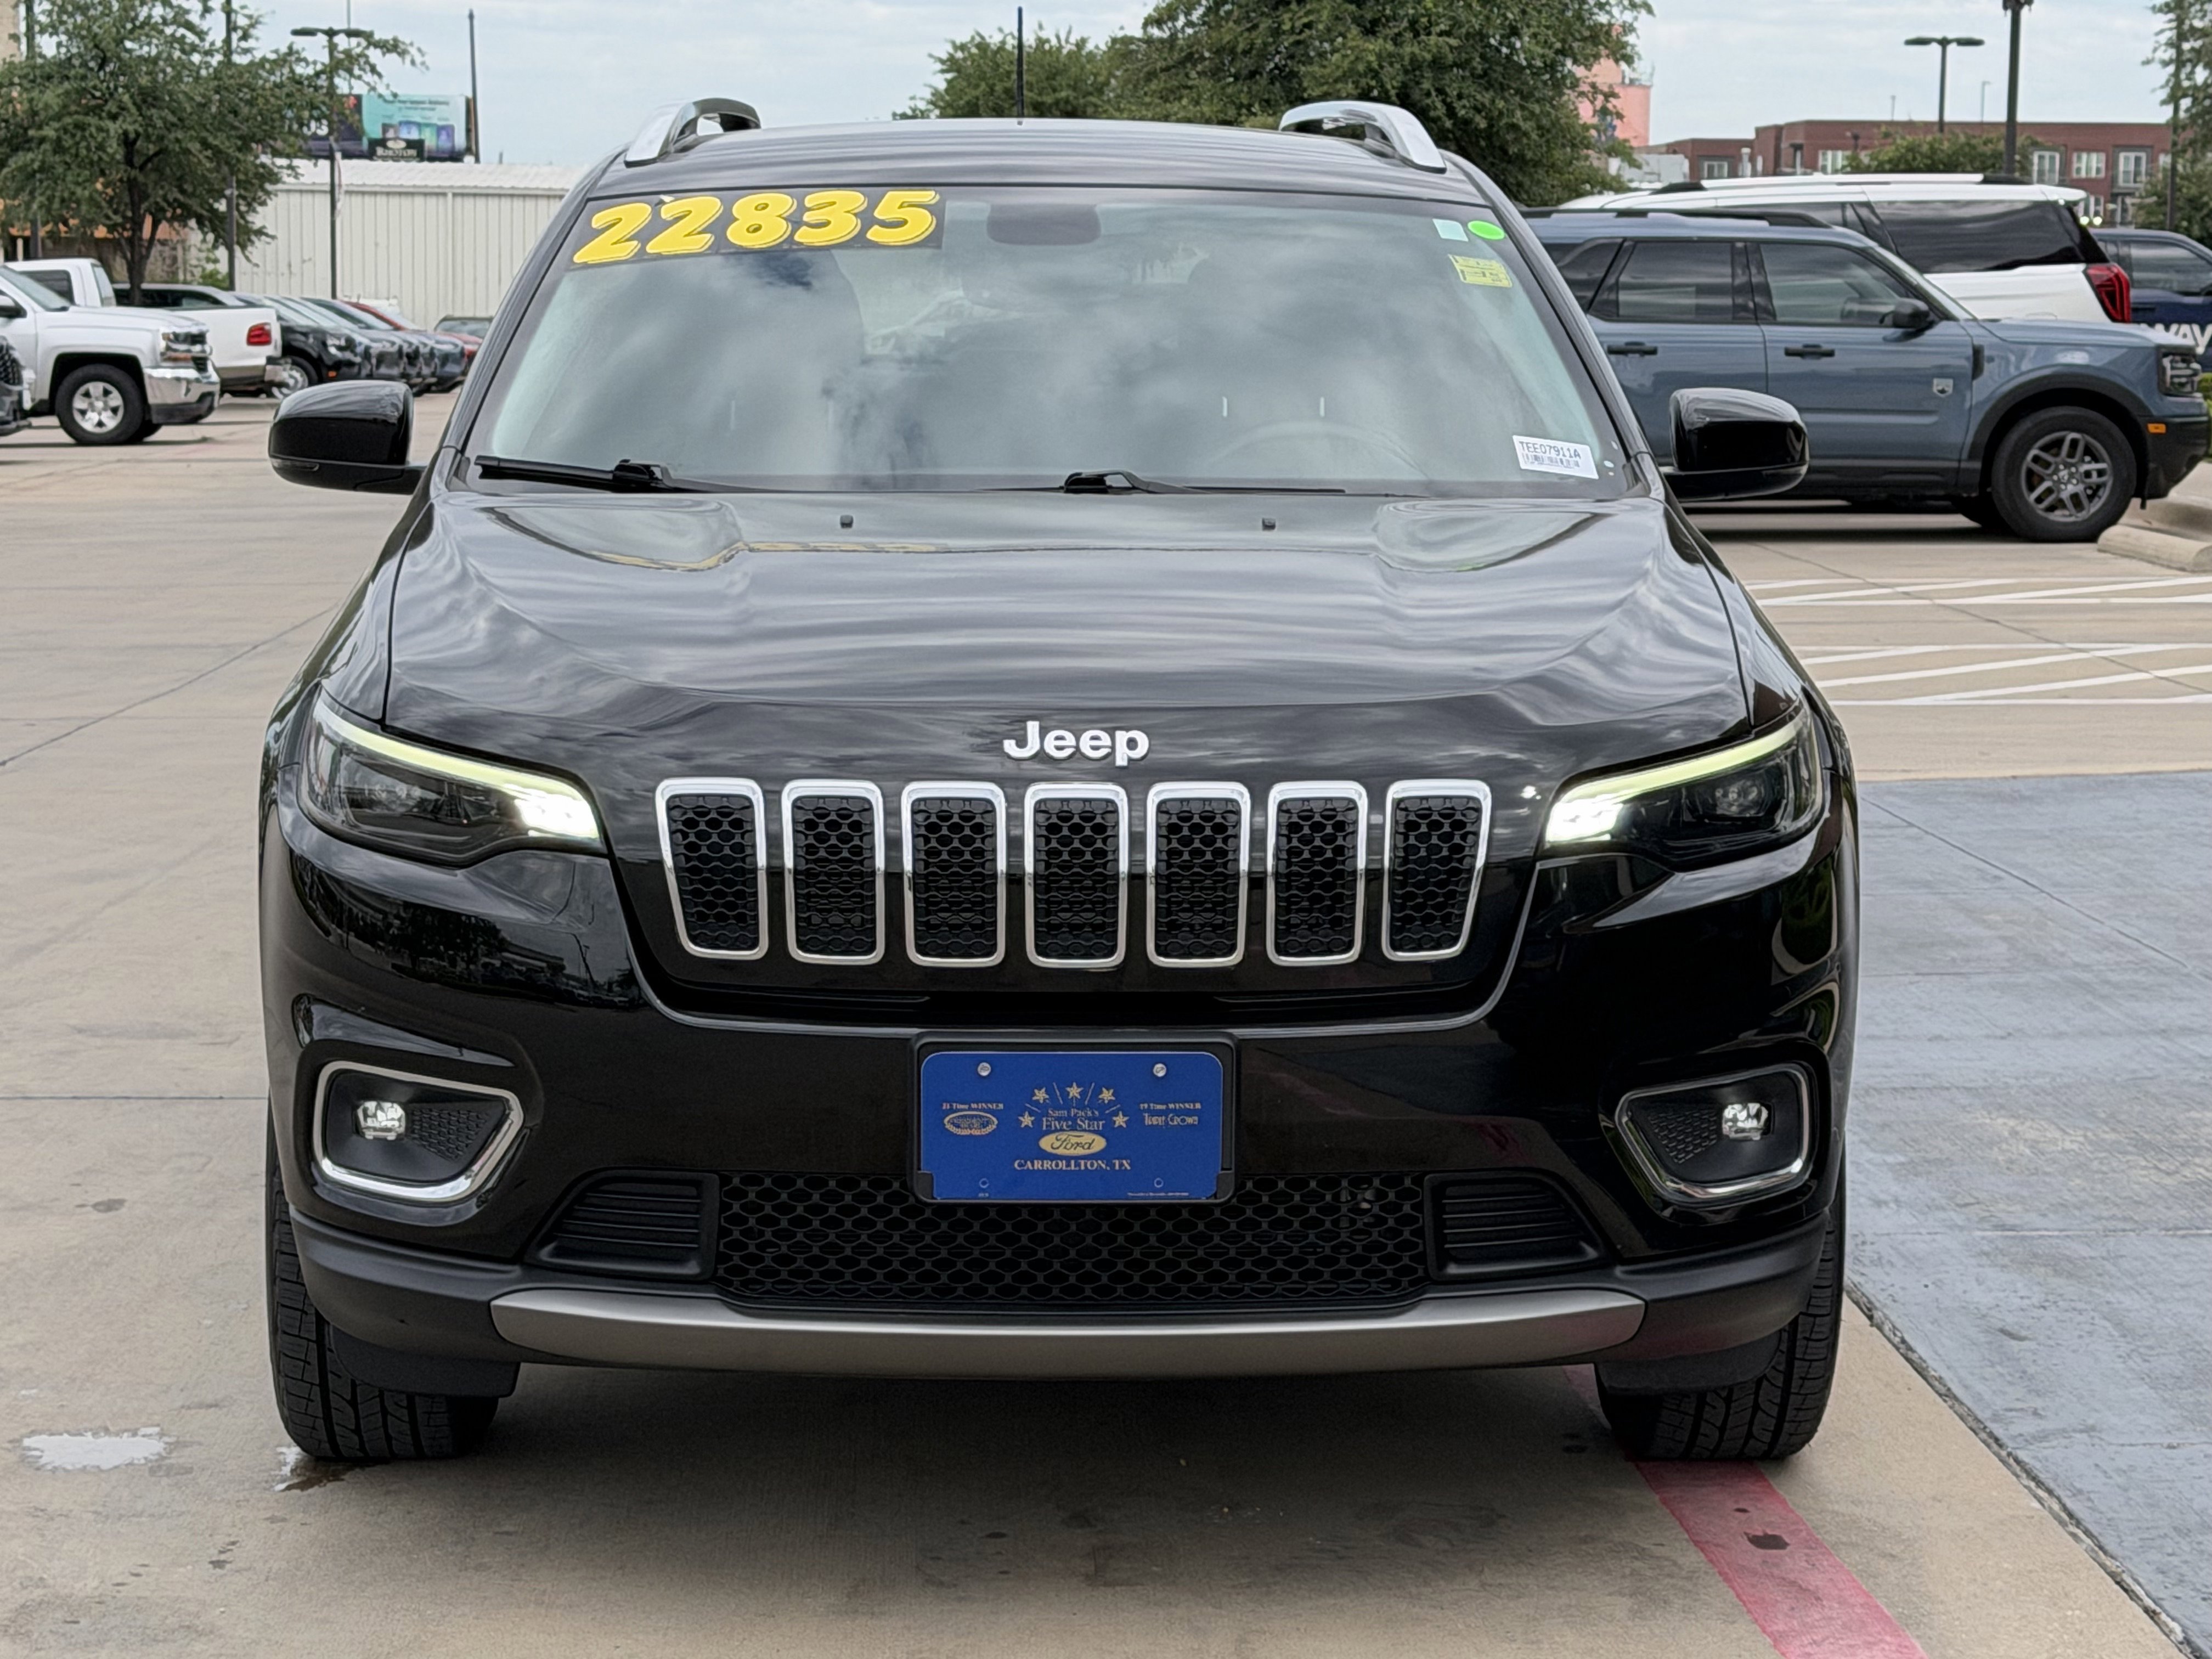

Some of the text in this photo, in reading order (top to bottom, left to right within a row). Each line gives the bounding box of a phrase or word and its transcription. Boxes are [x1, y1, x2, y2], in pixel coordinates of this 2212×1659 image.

[573, 189, 940, 264] 22835
[1518, 441, 1581, 459] TEE07911A
[1002, 720, 1149, 766] Jeep
[1048, 1107, 1099, 1117] Sam Pack's
[1042, 1117, 1105, 1130] Five Star
[1051, 1133, 1096, 1150] Ford
[1112, 1159, 1131, 1170] TX
